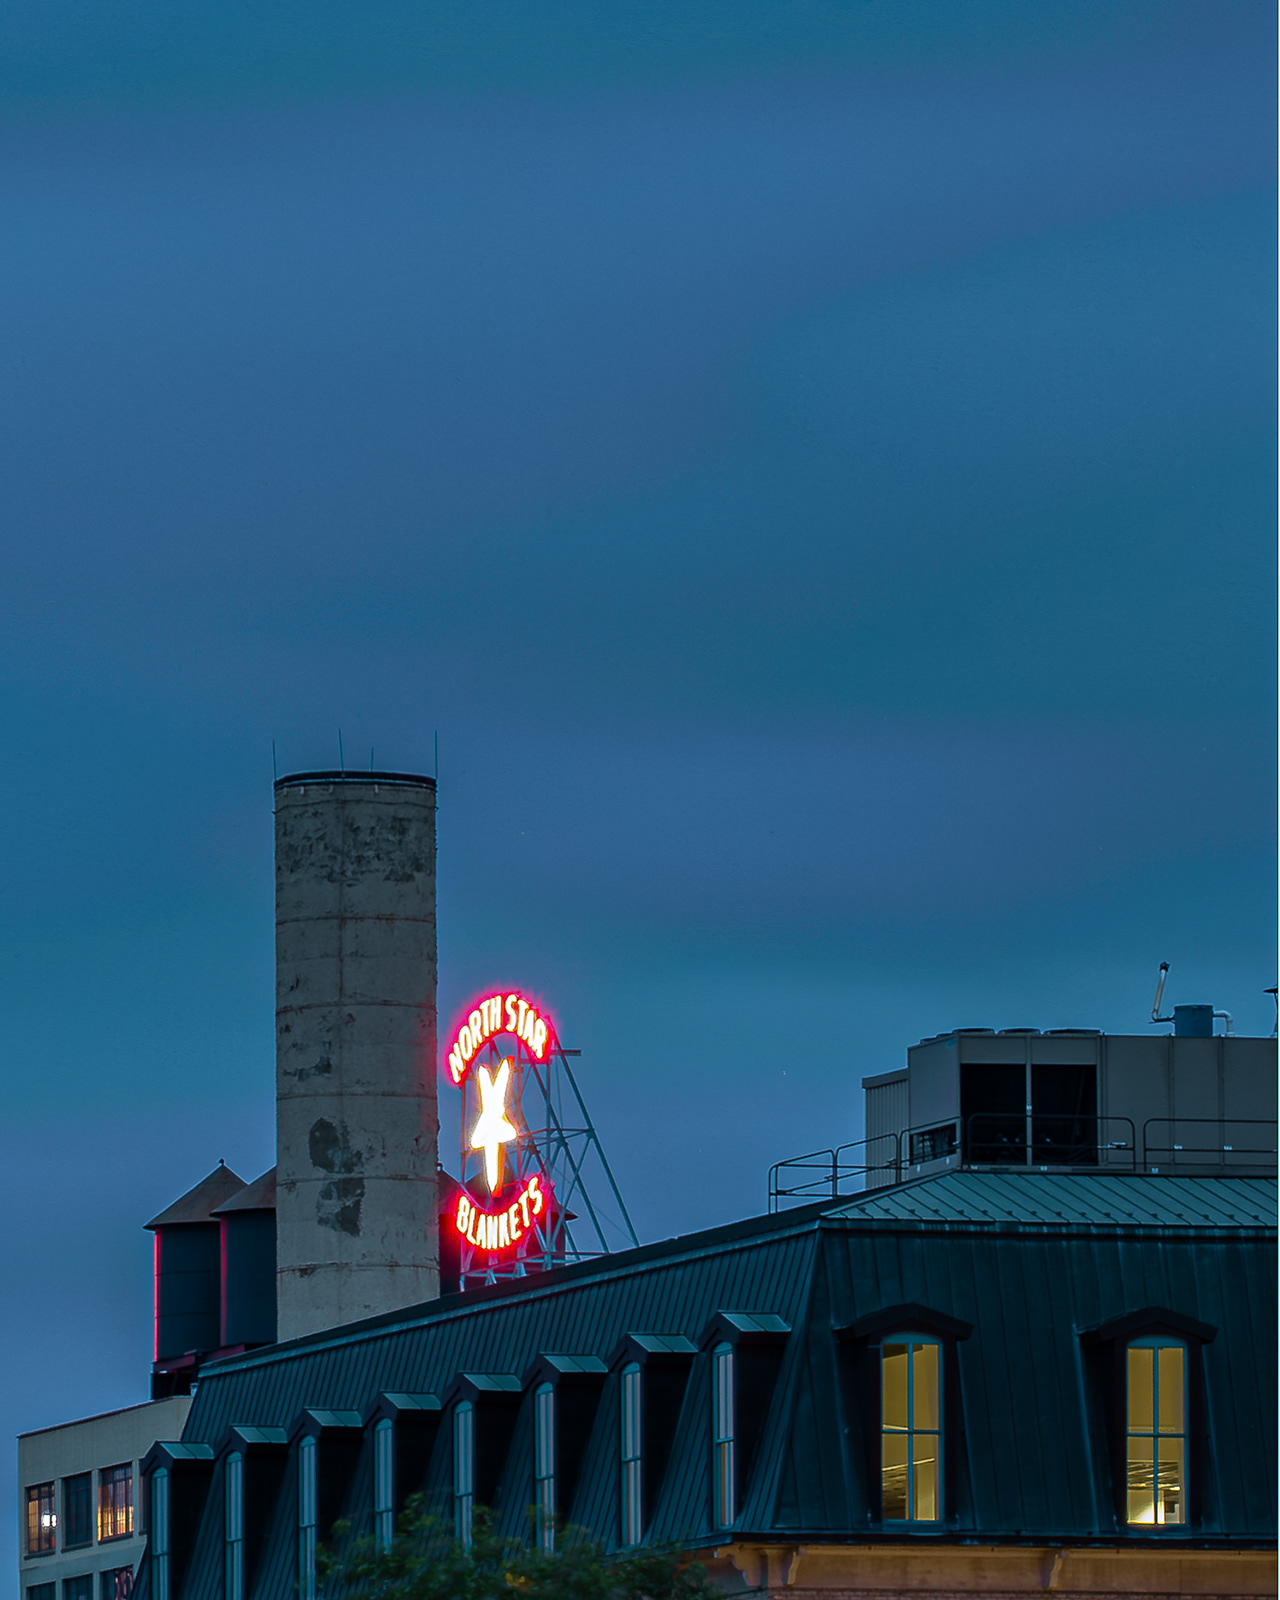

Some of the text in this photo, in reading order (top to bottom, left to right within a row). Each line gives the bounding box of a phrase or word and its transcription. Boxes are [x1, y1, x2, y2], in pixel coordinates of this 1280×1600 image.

[448, 993, 547, 1084] NORTH STAR
[456, 1176, 542, 1250] BLANKETS
